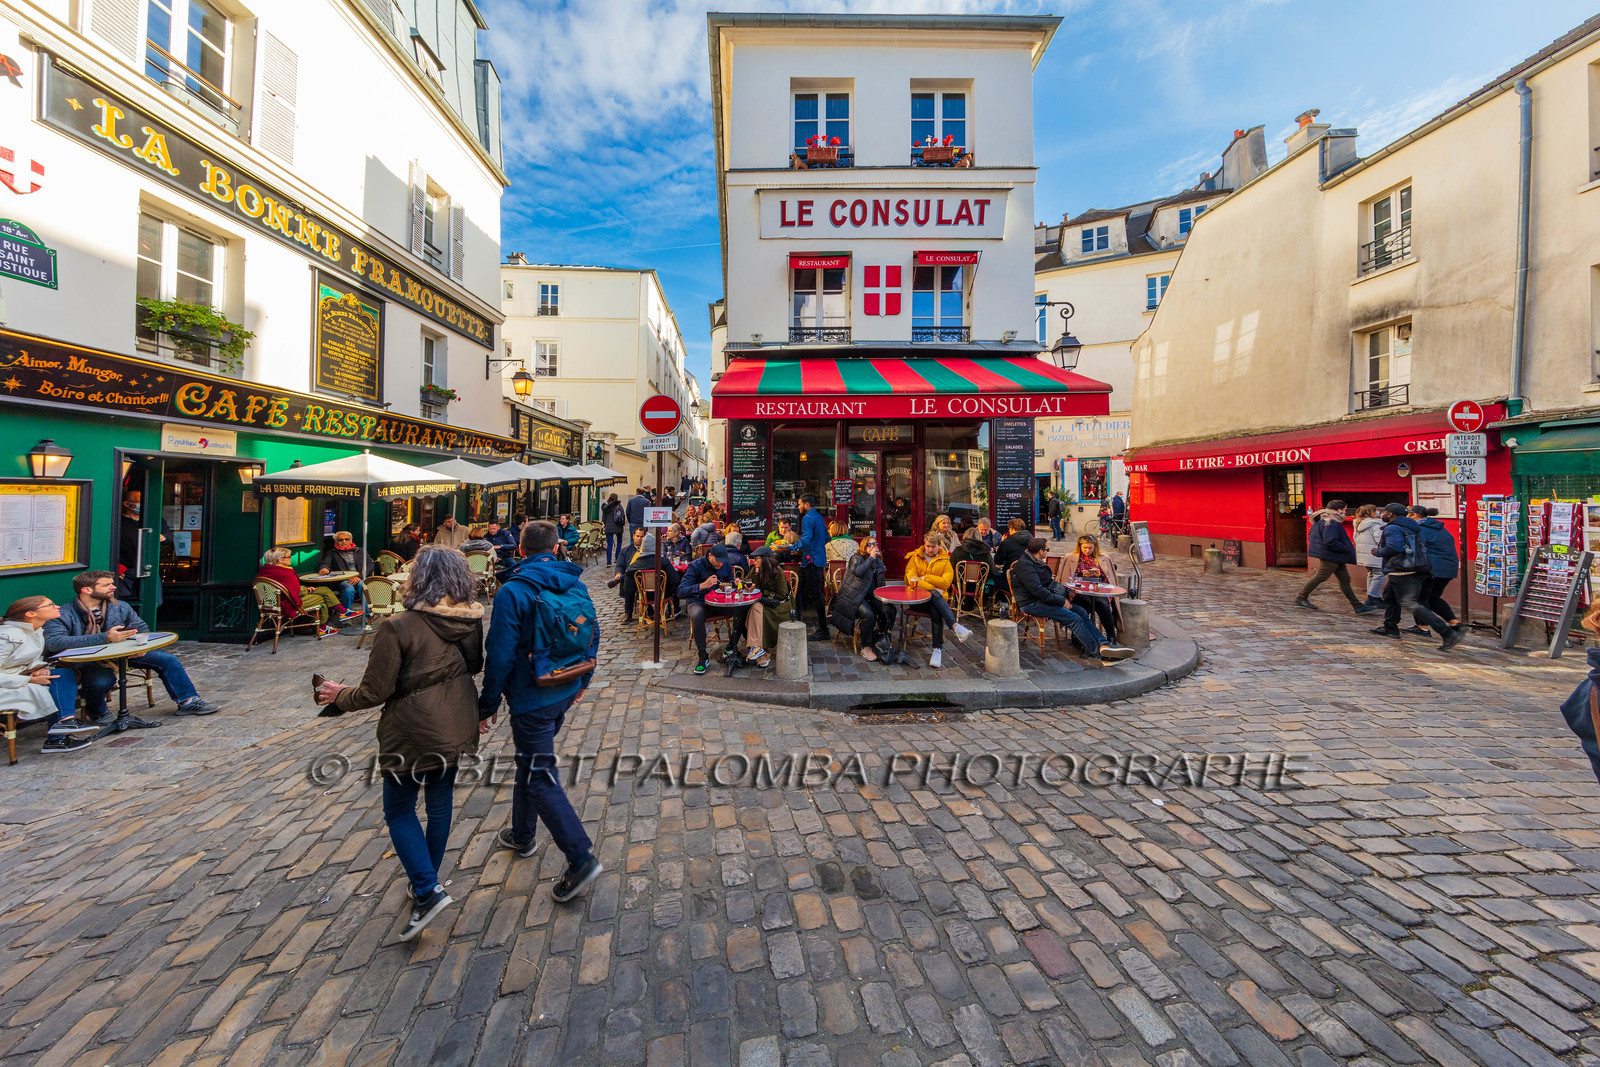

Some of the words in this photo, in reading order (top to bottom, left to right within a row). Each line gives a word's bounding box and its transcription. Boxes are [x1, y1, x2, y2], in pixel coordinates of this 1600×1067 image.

[91, 97, 180, 176] LA
[200, 159, 341, 262] BONNE
[350, 246, 486, 339] FRANQUETTE
[780, 200, 814, 228] LE
[829, 198, 991, 228] CONSULAT
[4, 240, 29, 256] RUE
[0, 260, 47, 280] STIQUE
[11, 350, 62, 370] Aimer,
[66, 355, 123, 383] Manger,
[37, 380, 84, 400] Boire
[87, 390, 104, 403] et
[756, 402, 867, 416] RESTAURANT
[910, 398, 937, 414] LE
[948, 396, 1066, 414] CONSULAT
[175, 382, 290, 428] CAFÉ
[301, 404, 456, 450] RESTAURANT
[464, 434, 493, 456] VINS
[544, 432, 561, 446] CAVE
[862, 426, 899, 442] CAFÉ
[1180, 459, 1194, 470] LE
[1196, 457, 1225, 468] TIRE
[1235, 448, 1311, 466] BOUCHON
[260, 485, 271, 493] LA
[274, 485, 302, 494] BONNE
[304, 485, 360, 496] FRANQUETTE
[378, 488, 388, 496] LA
[390, 486, 415, 496] BONNE
[416, 484, 456, 493] FRANQUETTE
[1542, 552, 1578, 562] MUSIC
[1574, 568, 1588, 596] MUSIC
